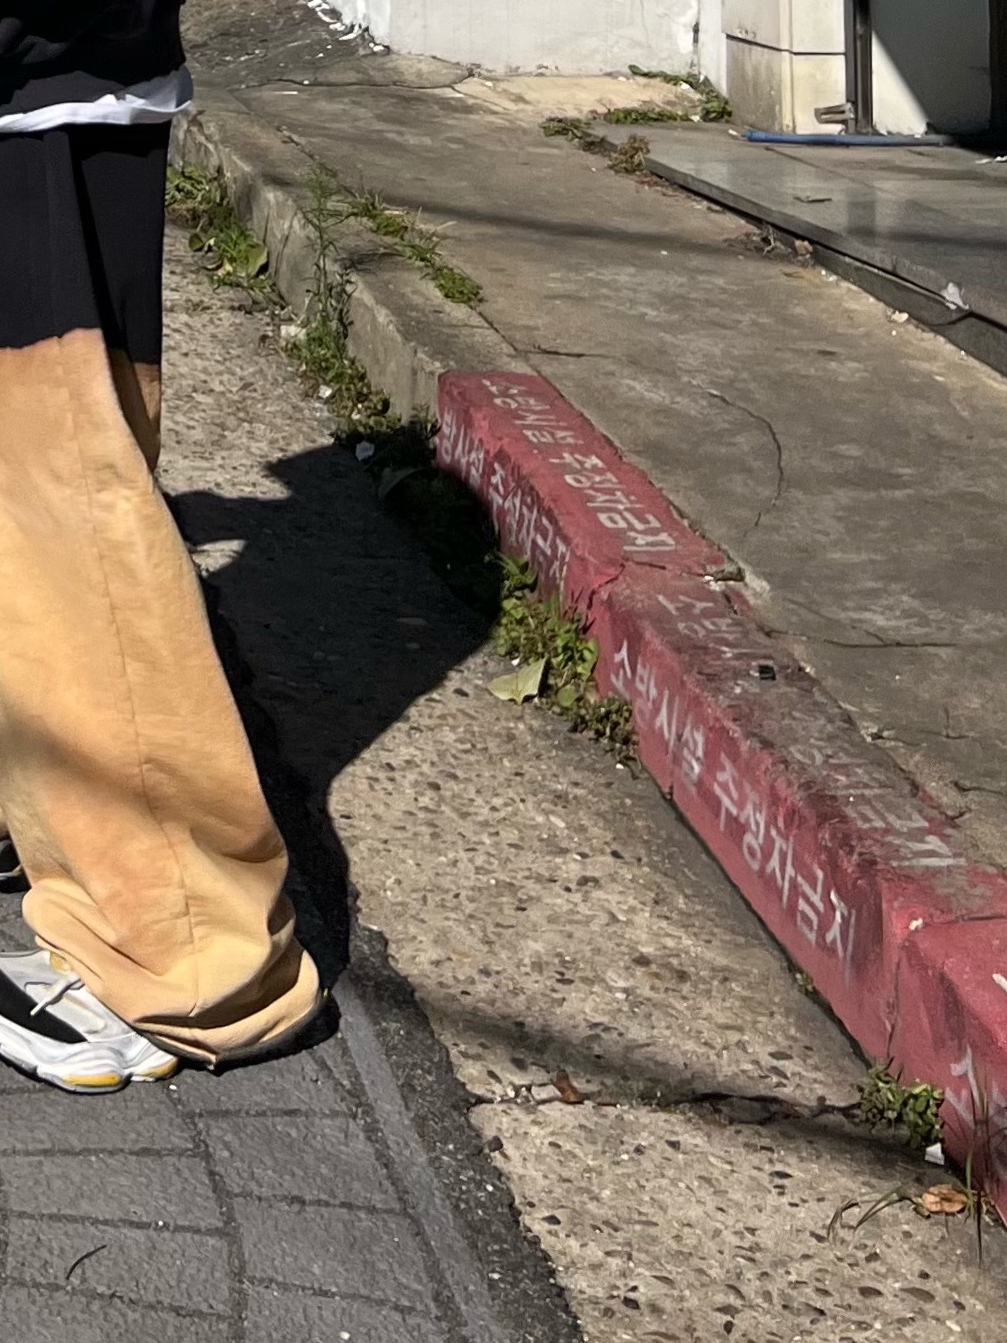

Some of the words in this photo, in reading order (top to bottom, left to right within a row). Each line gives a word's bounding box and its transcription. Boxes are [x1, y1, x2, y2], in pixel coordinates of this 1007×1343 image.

[482, 379, 584, 445] 소방시설
[549, 452, 676, 552] 주정차금지
[610, 639, 704, 787] 소방시설
